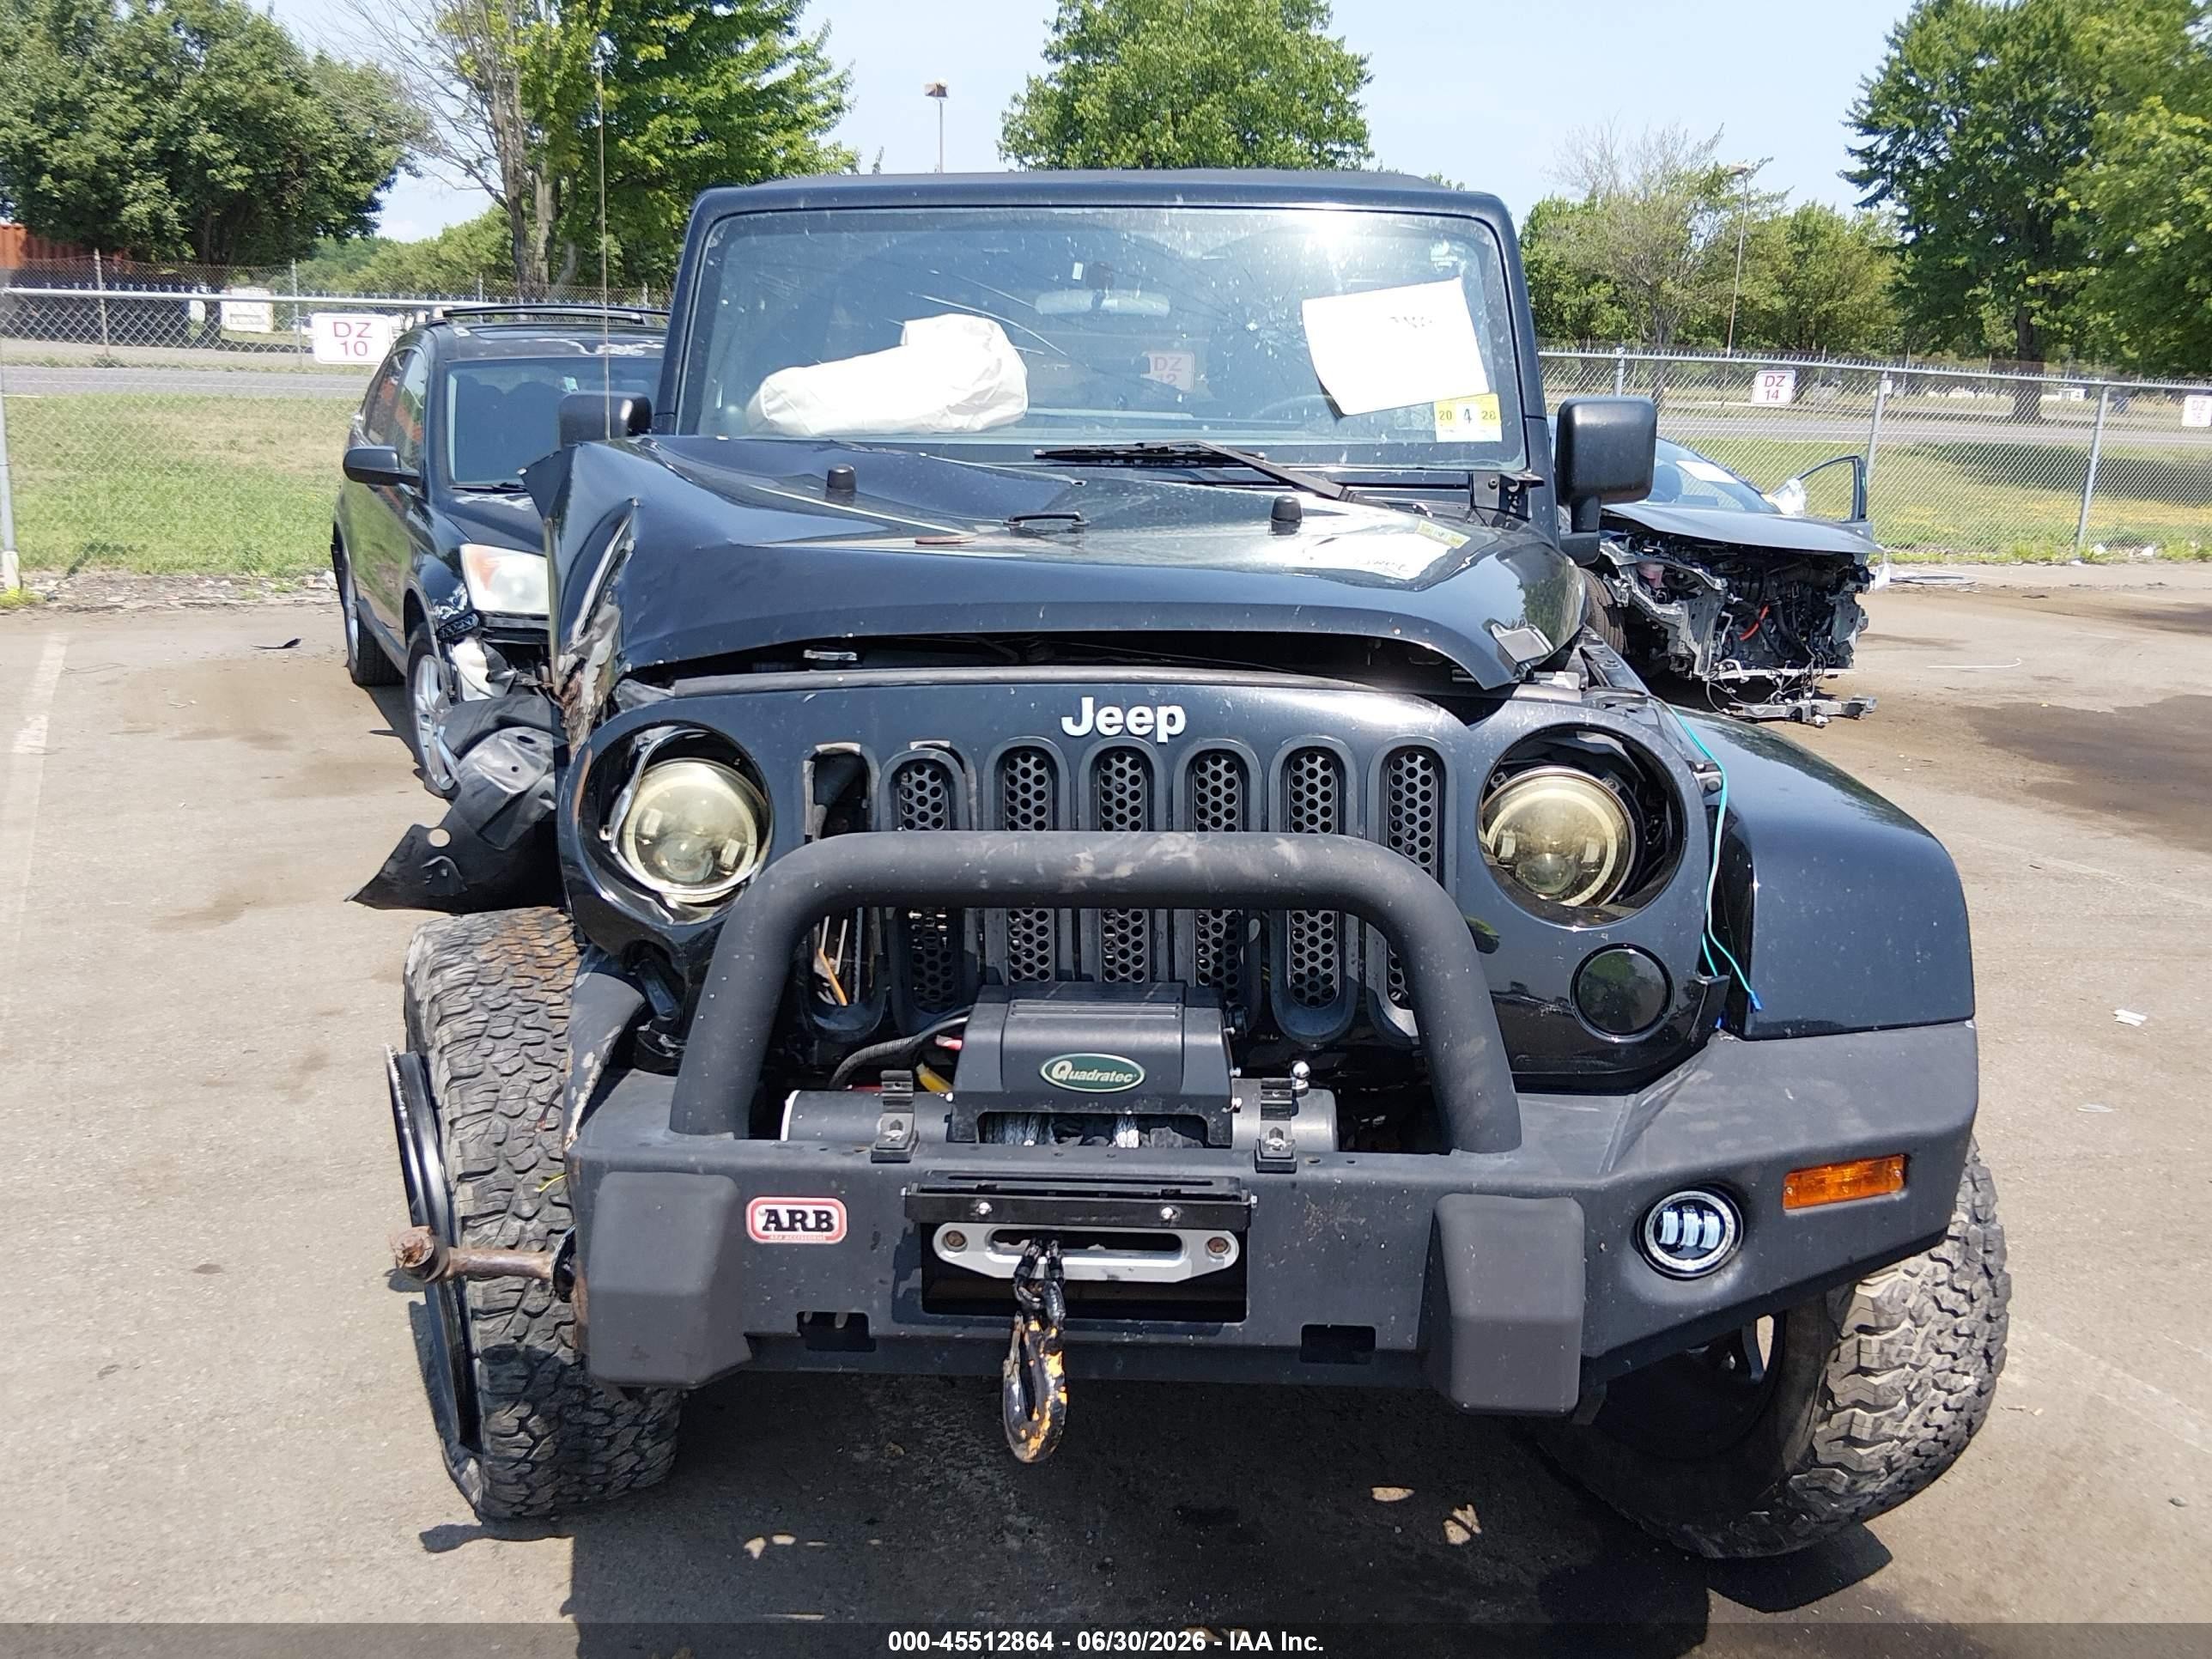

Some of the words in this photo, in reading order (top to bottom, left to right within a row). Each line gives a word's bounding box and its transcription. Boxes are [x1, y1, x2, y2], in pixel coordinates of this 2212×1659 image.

[333, 321, 373, 338] DZ
[339, 341, 368, 356] 10
[1153, 356, 1182, 371] DZ
[1765, 375, 1786, 387] DZ
[1765, 390, 1779, 401] 14
[1438, 410, 1452, 421] 20
[1463, 408, 1473, 424] 4
[1060, 696, 1186, 744] Jeep
[1051, 1060, 1133, 1083] Quadratec
[762, 1208, 835, 1232] ARB
